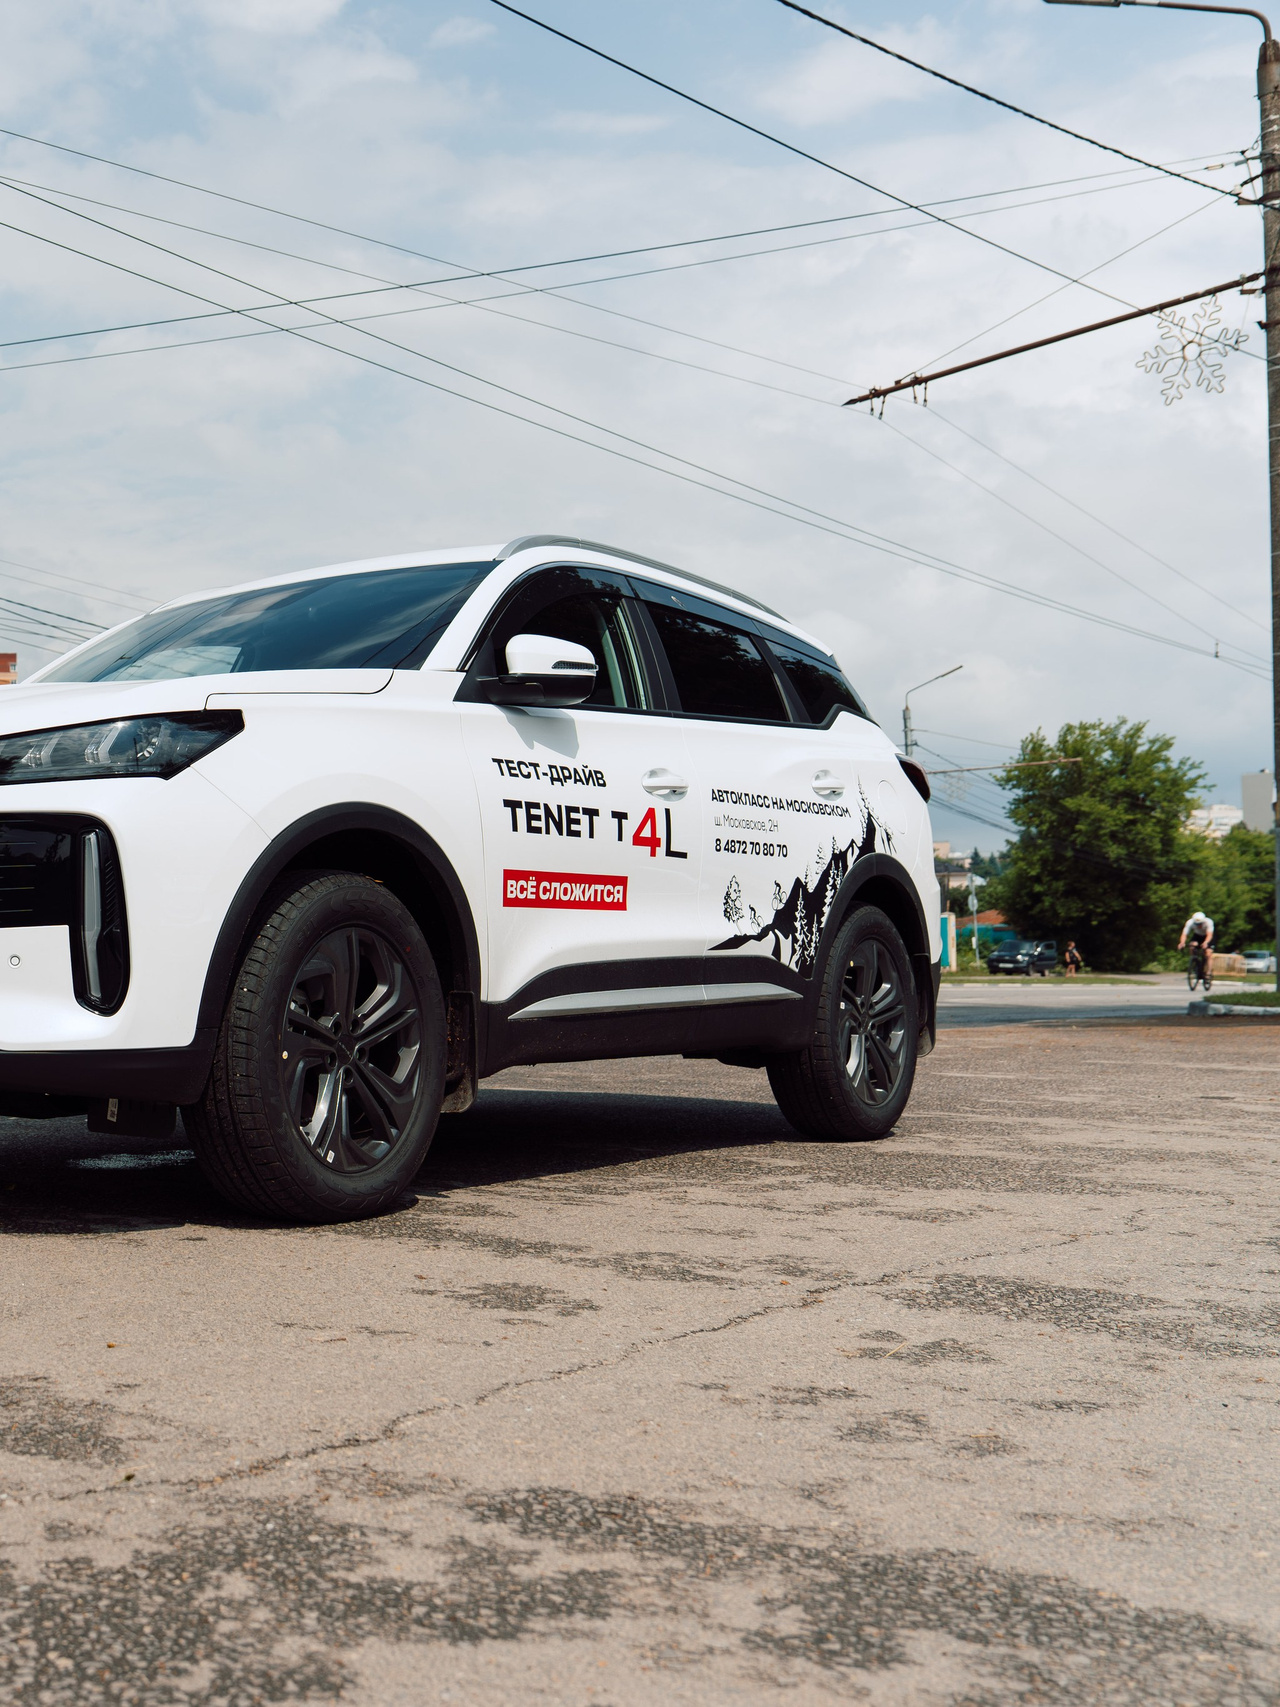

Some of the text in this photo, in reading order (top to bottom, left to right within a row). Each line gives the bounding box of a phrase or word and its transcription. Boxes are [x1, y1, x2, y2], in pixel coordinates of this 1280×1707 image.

[491, 757, 607, 788] ТЕСТ-ДРАЙВ
[711, 788, 852, 818] АВТОКЛАСС НА МОСКОВСКОМ
[502, 798, 688, 860] TENET T4L
[723, 814, 768, 833] Московское,
[714, 837, 788, 858] 8 4872 70 80 70
[506, 876, 624, 903] ВСЁ СЛОЖИТСЯ
